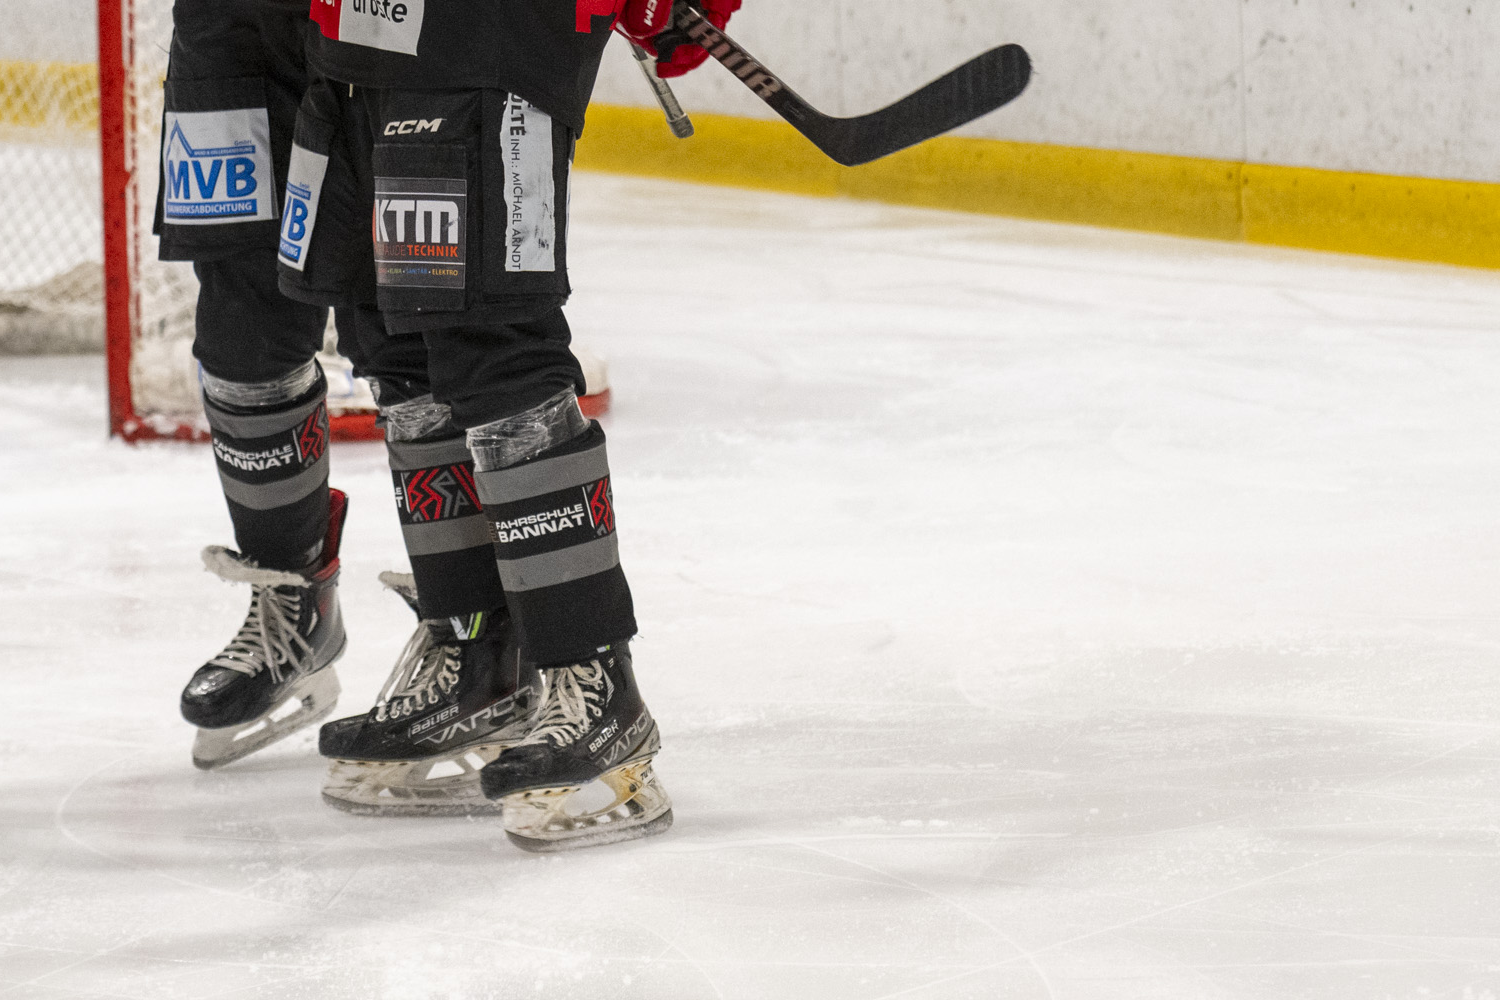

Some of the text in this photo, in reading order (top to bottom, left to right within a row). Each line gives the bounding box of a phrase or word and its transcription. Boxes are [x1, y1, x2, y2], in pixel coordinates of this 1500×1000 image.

[384, 118, 444, 136] CCM
[168, 157, 257, 199] MVB
[512, 172, 523, 225] MICHAEL
[374, 199, 459, 244] KTM
[512, 228, 522, 270] ARNDT
[213, 437, 293, 460] FAHRSCHULE
[214, 454, 294, 472] BANNAT
[496, 503, 584, 532] FAHRSCHULE
[498, 514, 585, 544] BANNAT
[410, 704, 460, 736] BAUER
[588, 719, 620, 753] BAUER
[601, 711, 651, 766] VAPO
